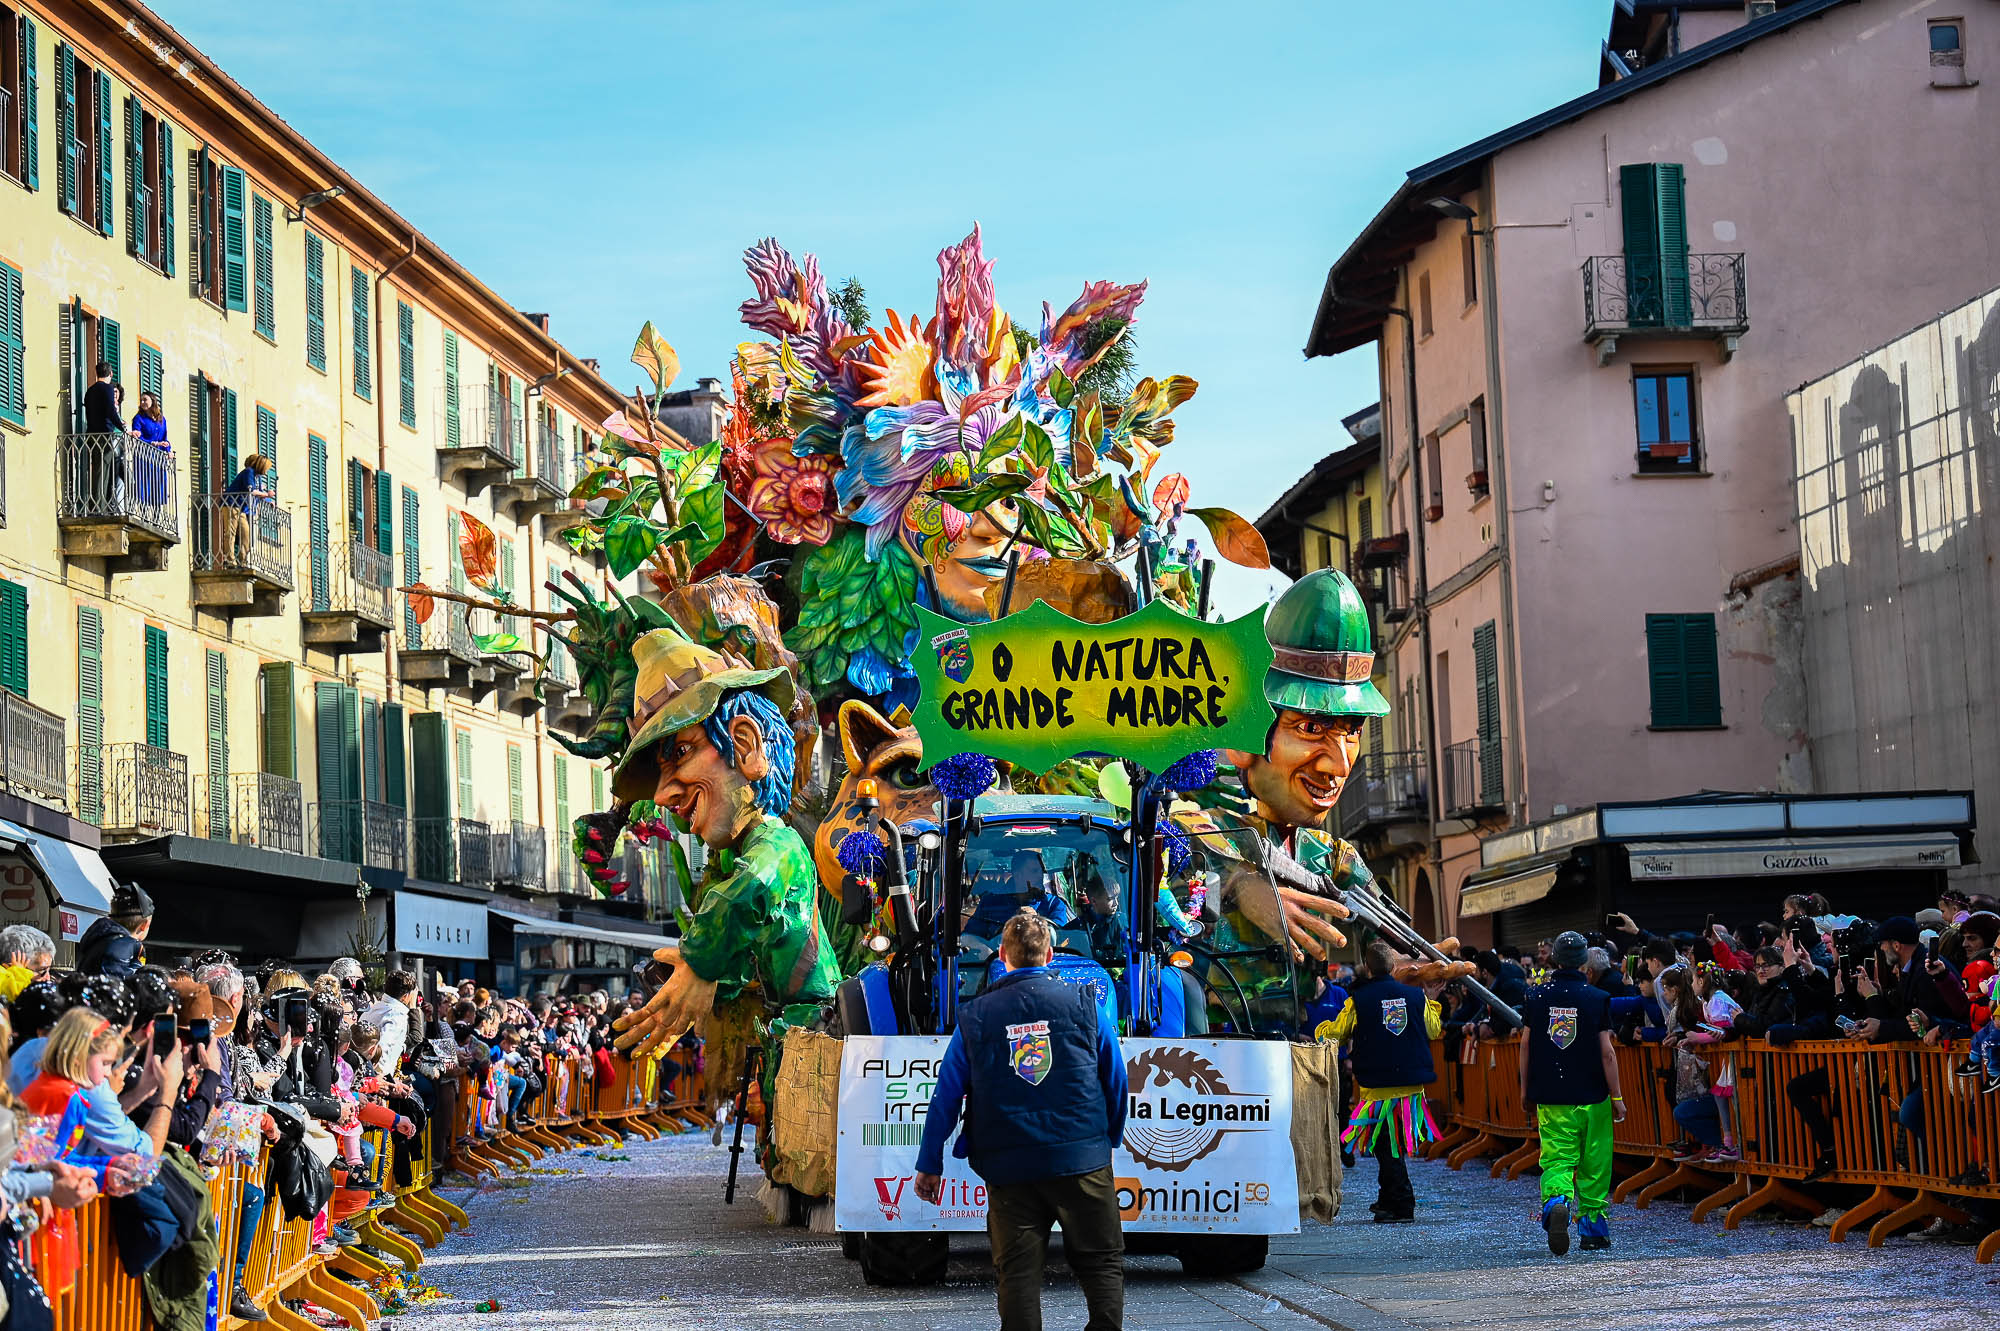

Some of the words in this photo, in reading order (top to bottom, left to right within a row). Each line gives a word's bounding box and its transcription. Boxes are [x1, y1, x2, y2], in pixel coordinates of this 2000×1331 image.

[993, 642, 1013, 682] O
[1052, 637, 1229, 687] NATURA,
[942, 686, 1074, 731] GRANDE
[1107, 685, 1228, 728] MADRE
[1643, 862, 1673, 872] Pellini
[1763, 854, 1829, 869] Gazzetta
[416, 923, 471, 945] SISLEY
[1160, 1097, 1270, 1126] Legnami
[940, 1209, 984, 1219] RISTORANTE
[1141, 1213, 1240, 1224] FERRAMENTA
